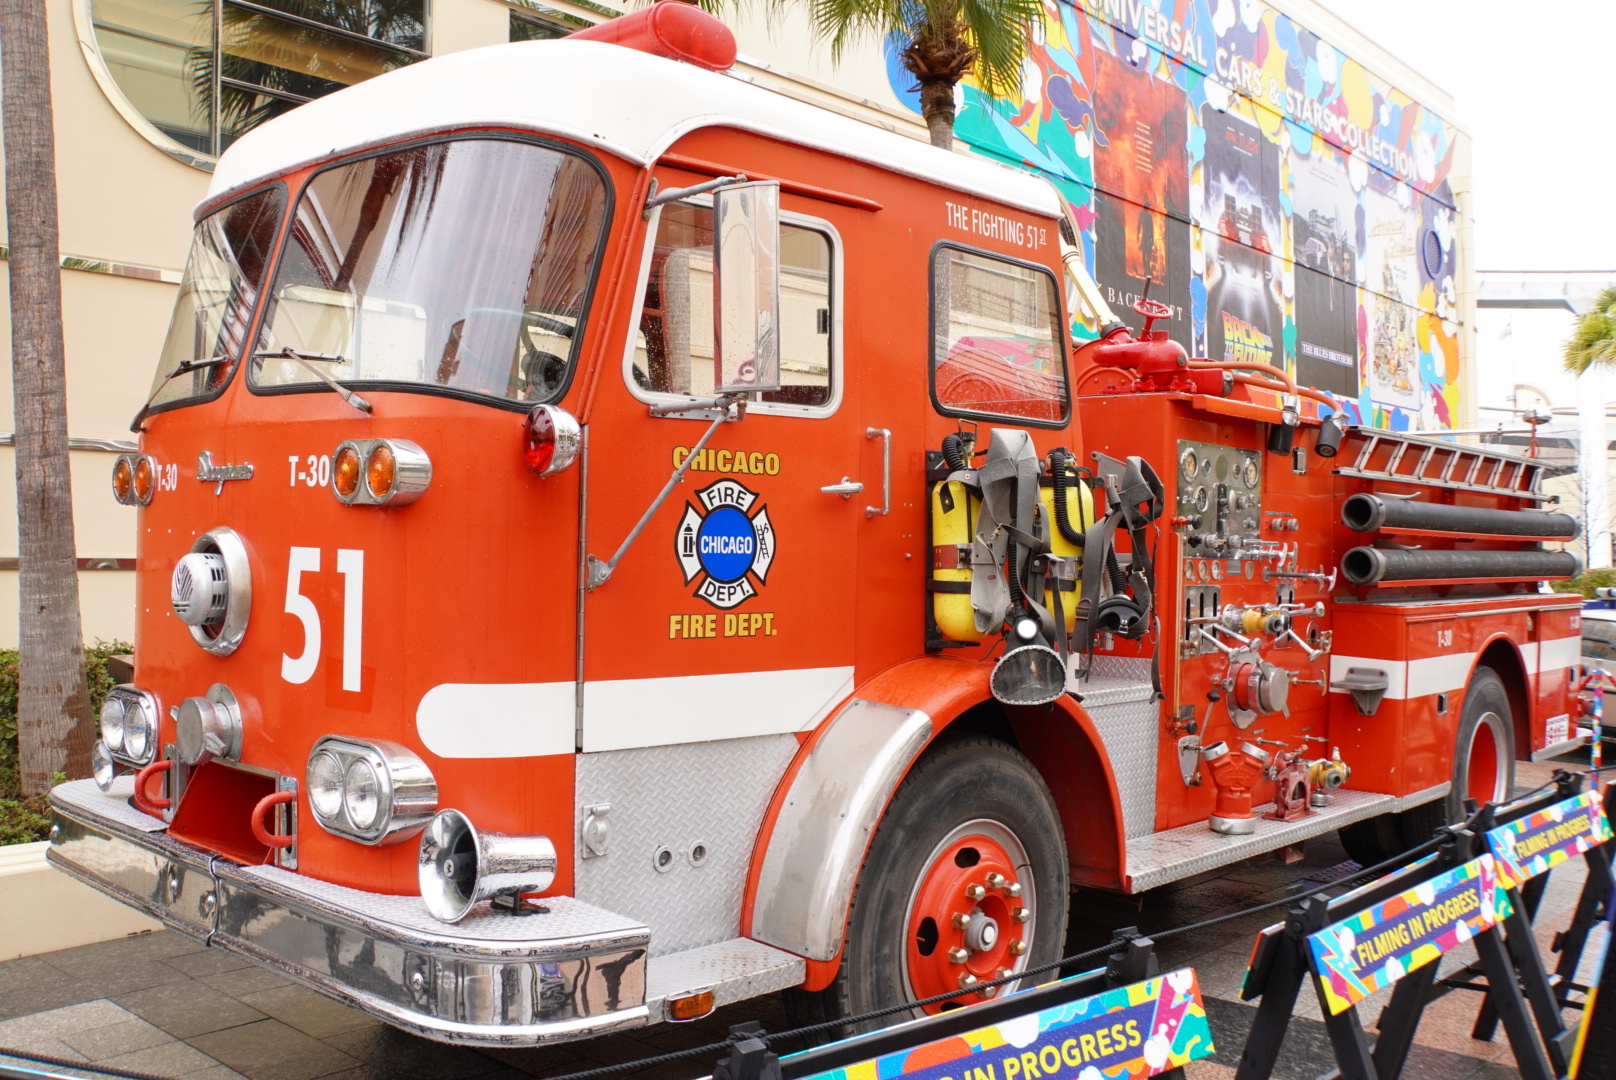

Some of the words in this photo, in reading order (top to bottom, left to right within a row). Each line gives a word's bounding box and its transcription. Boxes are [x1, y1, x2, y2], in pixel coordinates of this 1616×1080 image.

[1088, 0, 1207, 67] NIVERSAL
[1215, 47, 1262, 97] CARS
[1268, 76, 1282, 107] &
[1285, 86, 1334, 134] STARS
[1337, 116, 1419, 182] COLLECTION
[945, 202, 969, 231] THE
[972, 209, 1024, 246] FIGHTING
[1107, 287, 1183, 321] BACKRFT
[1221, 310, 1268, 350] BACK
[1224, 340, 1234, 353] TO
[1233, 342, 1273, 365] FUTURE
[1302, 343, 1313, 354] THE
[1313, 346, 1328, 359] BLUES
[1328, 350, 1353, 366] BROTHERS
[289, 455, 330, 487] T-30
[672, 446, 780, 476] CHICAGO
[157, 463, 178, 491] T-30
[706, 486, 747, 507] FIRE
[701, 535, 753, 554] CHICAGO
[704, 581, 750, 602] DEPT.
[281, 546, 364, 693] 51
[669, 614, 717, 639] FIRE
[723, 612, 777, 637] DEPT.
[1437, 629, 1452, 647] T-30
[1515, 832, 1550, 859] FILMING
[1545, 828, 1559, 846] IN
[1554, 814, 1591, 842] PROGRESS
[1356, 923, 1411, 967] FILMING
[1407, 916, 1426, 939] IN
[1422, 888, 1480, 932] PROGRESS
[1002, 1019, 1142, 1080] PROGRESS
